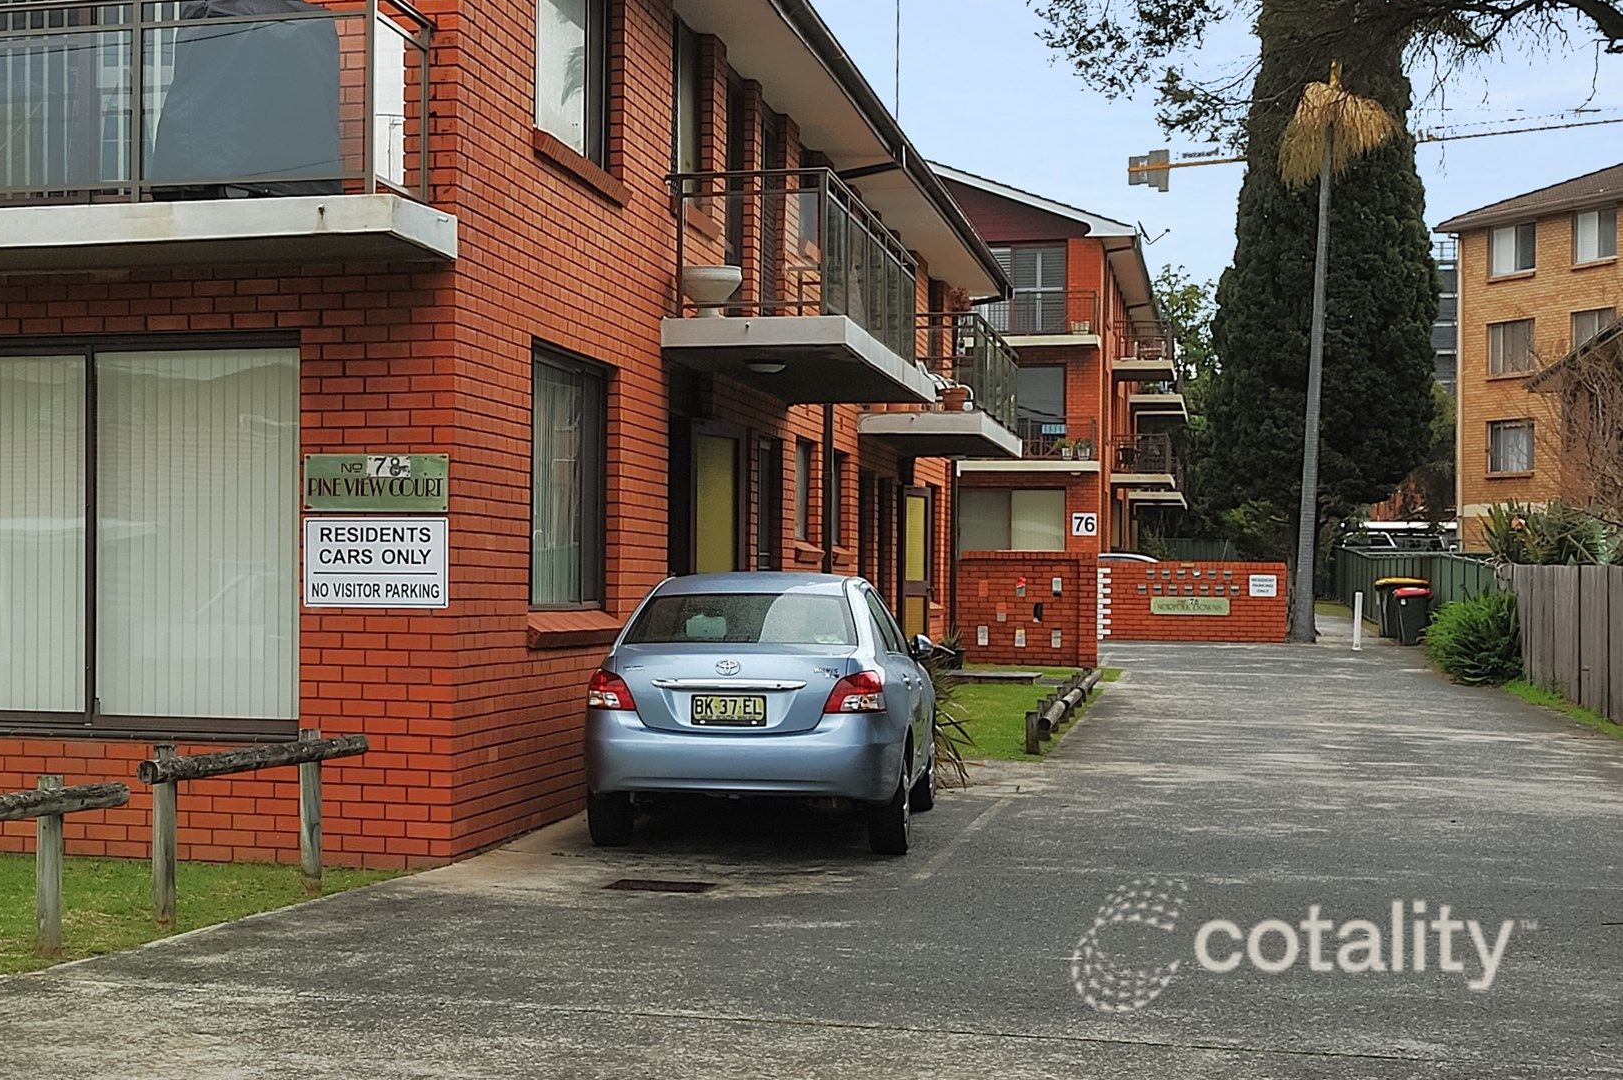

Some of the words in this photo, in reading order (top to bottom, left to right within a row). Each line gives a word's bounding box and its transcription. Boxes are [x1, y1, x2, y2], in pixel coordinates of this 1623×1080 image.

[307, 477, 341, 497] PINE
[344, 477, 387, 497] VIEW
[389, 477, 444, 498] COURT
[1074, 516, 1095, 532] 76
[319, 527, 431, 543] RESIDENTS
[319, 549, 373, 565] CARS
[381, 549, 432, 565] ONLY
[311, 582, 329, 598] NO
[333, 582, 381, 598] VISITOR
[385, 583, 440, 599] PARKING
